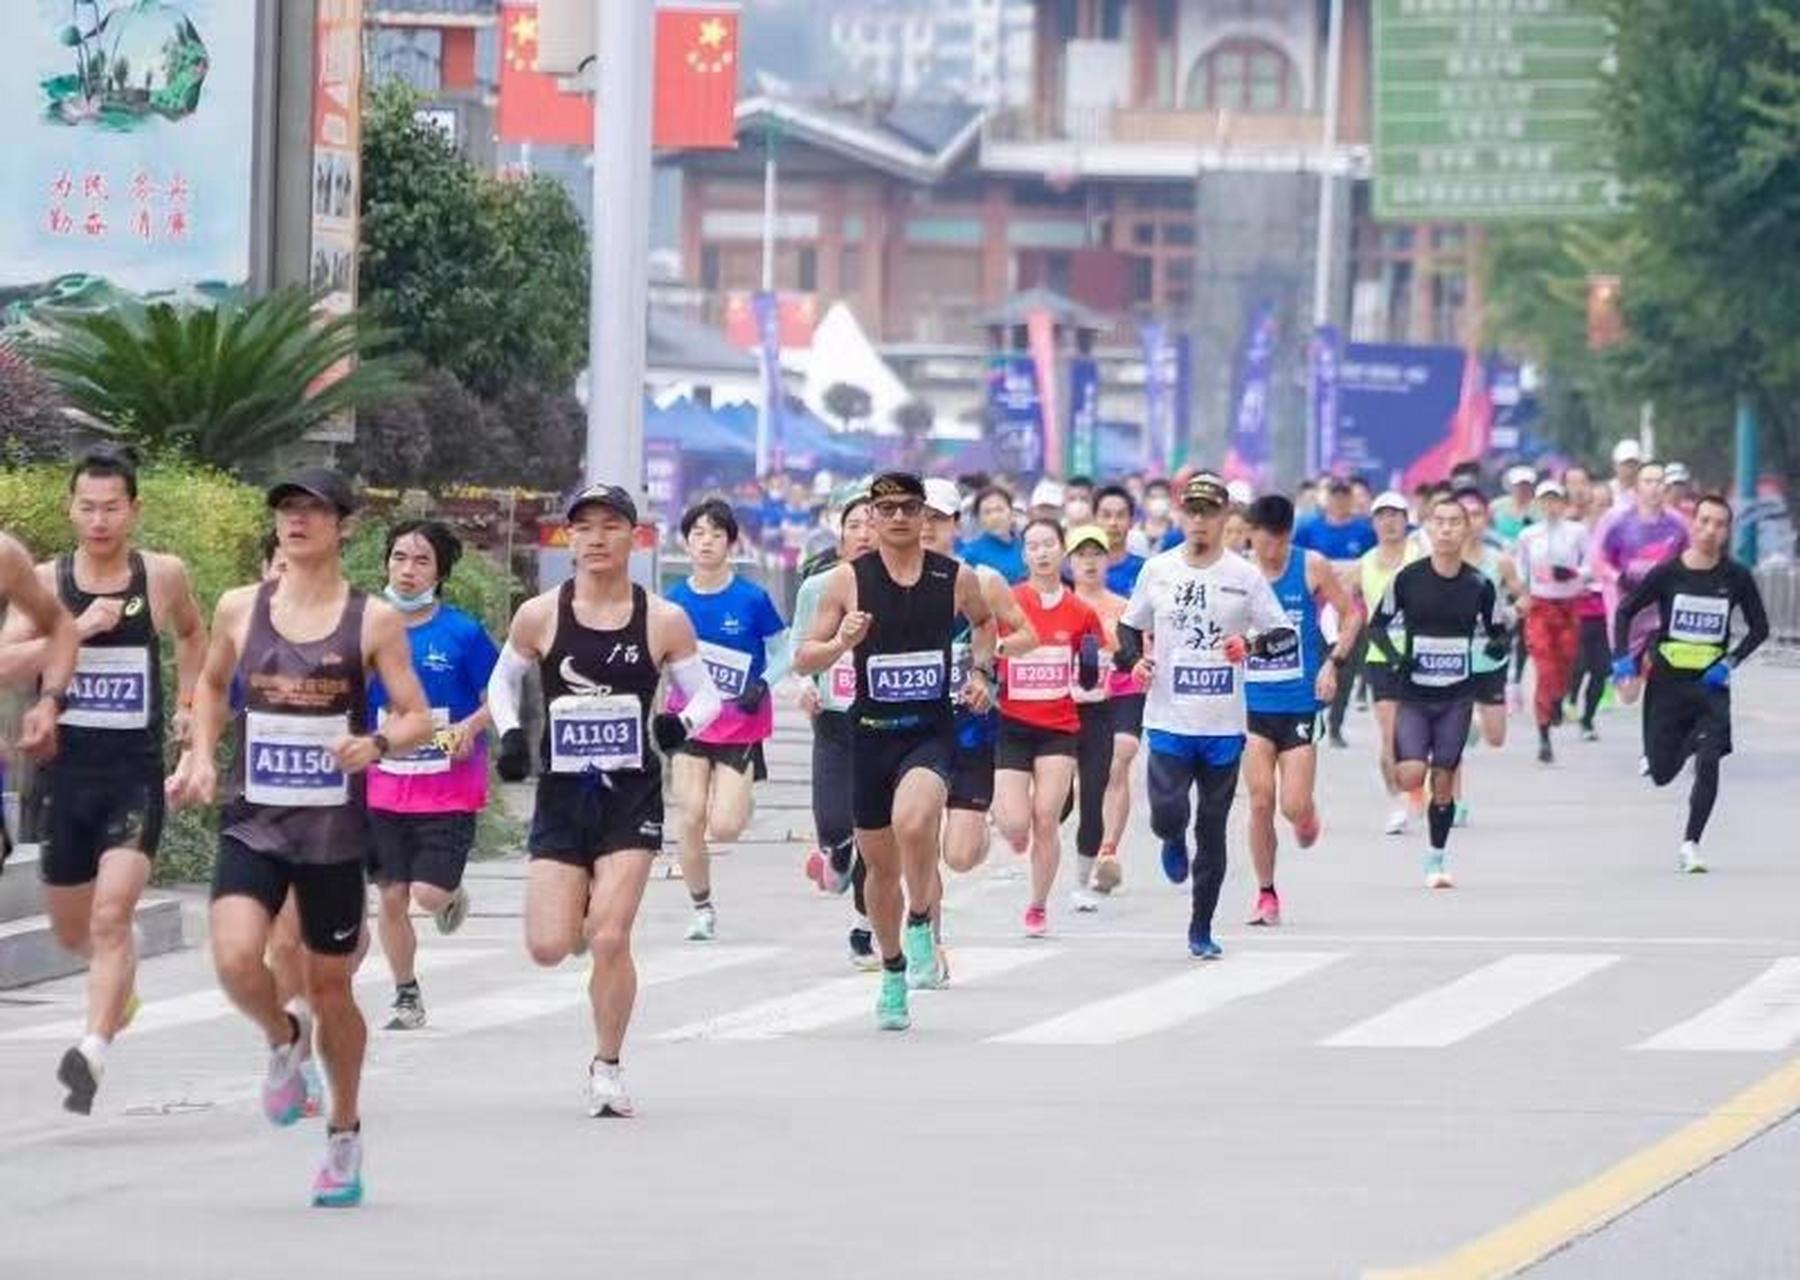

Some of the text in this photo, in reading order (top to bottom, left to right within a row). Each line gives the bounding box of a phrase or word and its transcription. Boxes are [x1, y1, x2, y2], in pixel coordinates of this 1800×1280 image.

[65, 676, 138, 700] A1072
[877, 667, 938, 689] A1230
[1177, 668, 1231, 687] A1077
[561, 721, 630, 745] A1103
[255, 747, 336, 775] A1150
